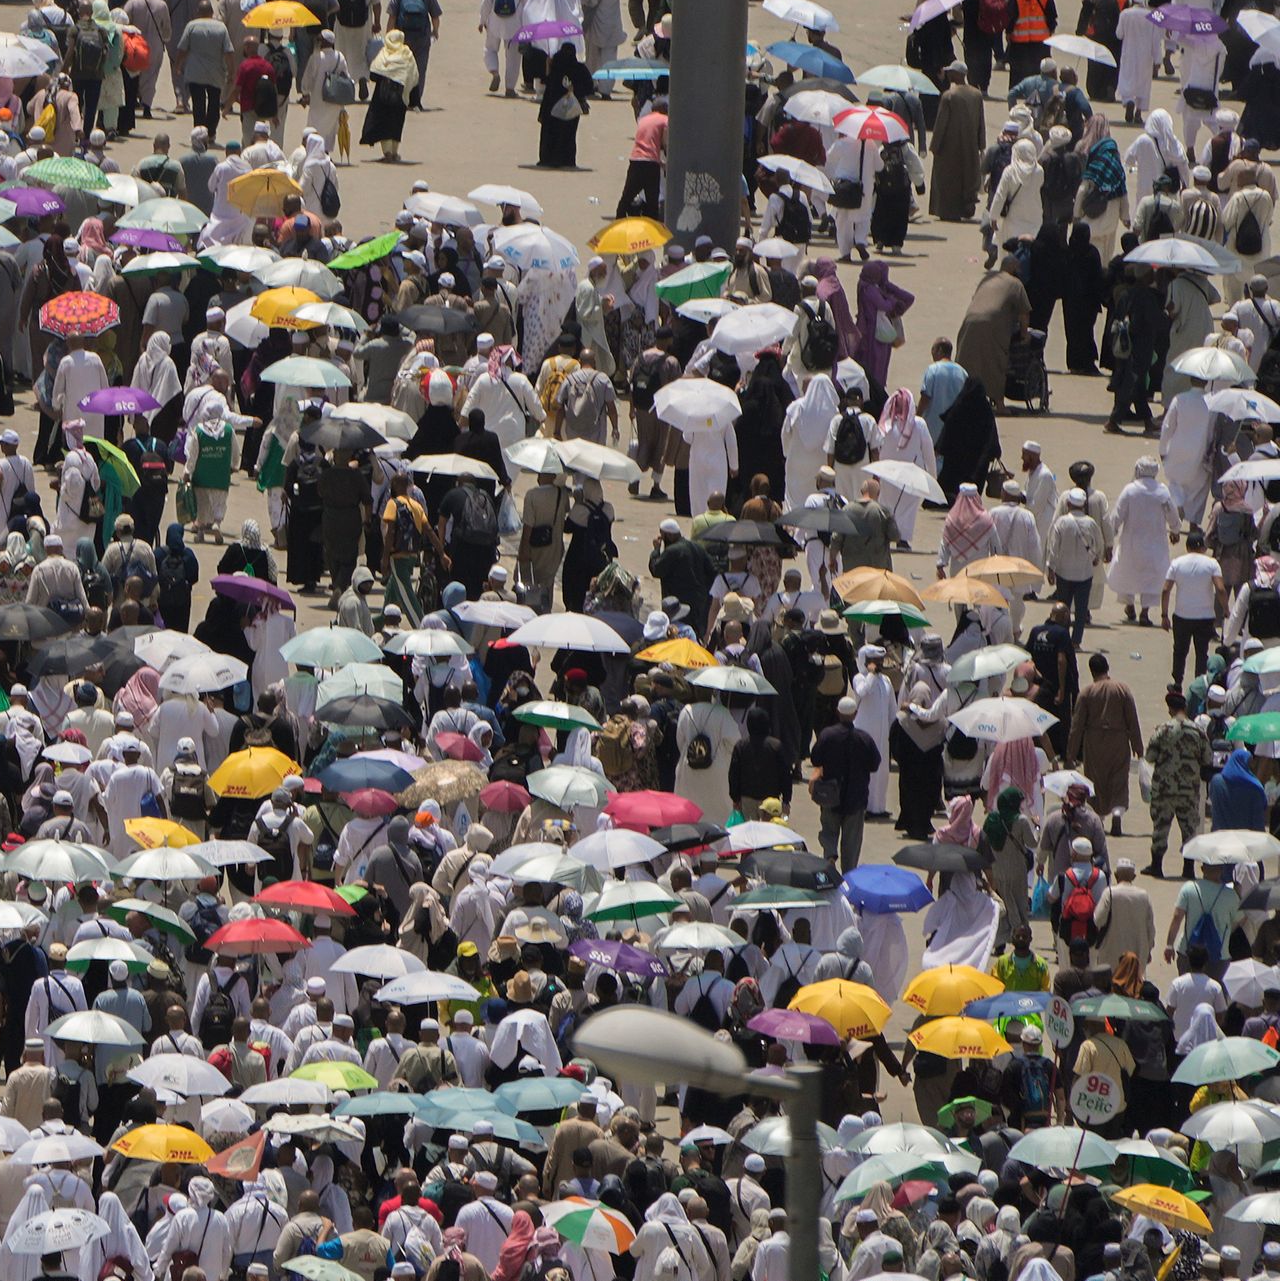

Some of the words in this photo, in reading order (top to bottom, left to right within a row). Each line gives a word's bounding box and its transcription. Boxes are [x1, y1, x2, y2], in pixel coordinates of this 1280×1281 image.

[1195, 22, 1213, 32] stc
[42, 200, 60, 211] stc
[630, 240, 651, 250] DHL
[276, 317, 299, 327] DHL
[115, 401, 136, 411] stc
[588, 951, 612, 963] stc
[1053, 999, 1068, 1021] 9A
[847, 1024, 871, 1038] DHL
[1047, 1017, 1070, 1037] Рейс
[958, 1045, 983, 1055] DHL
[1087, 1075, 1110, 1096] 9B
[1076, 1094, 1112, 1114] Рейс
[170, 1150, 195, 1159] DHL
[1154, 1199, 1181, 1213] DHL
